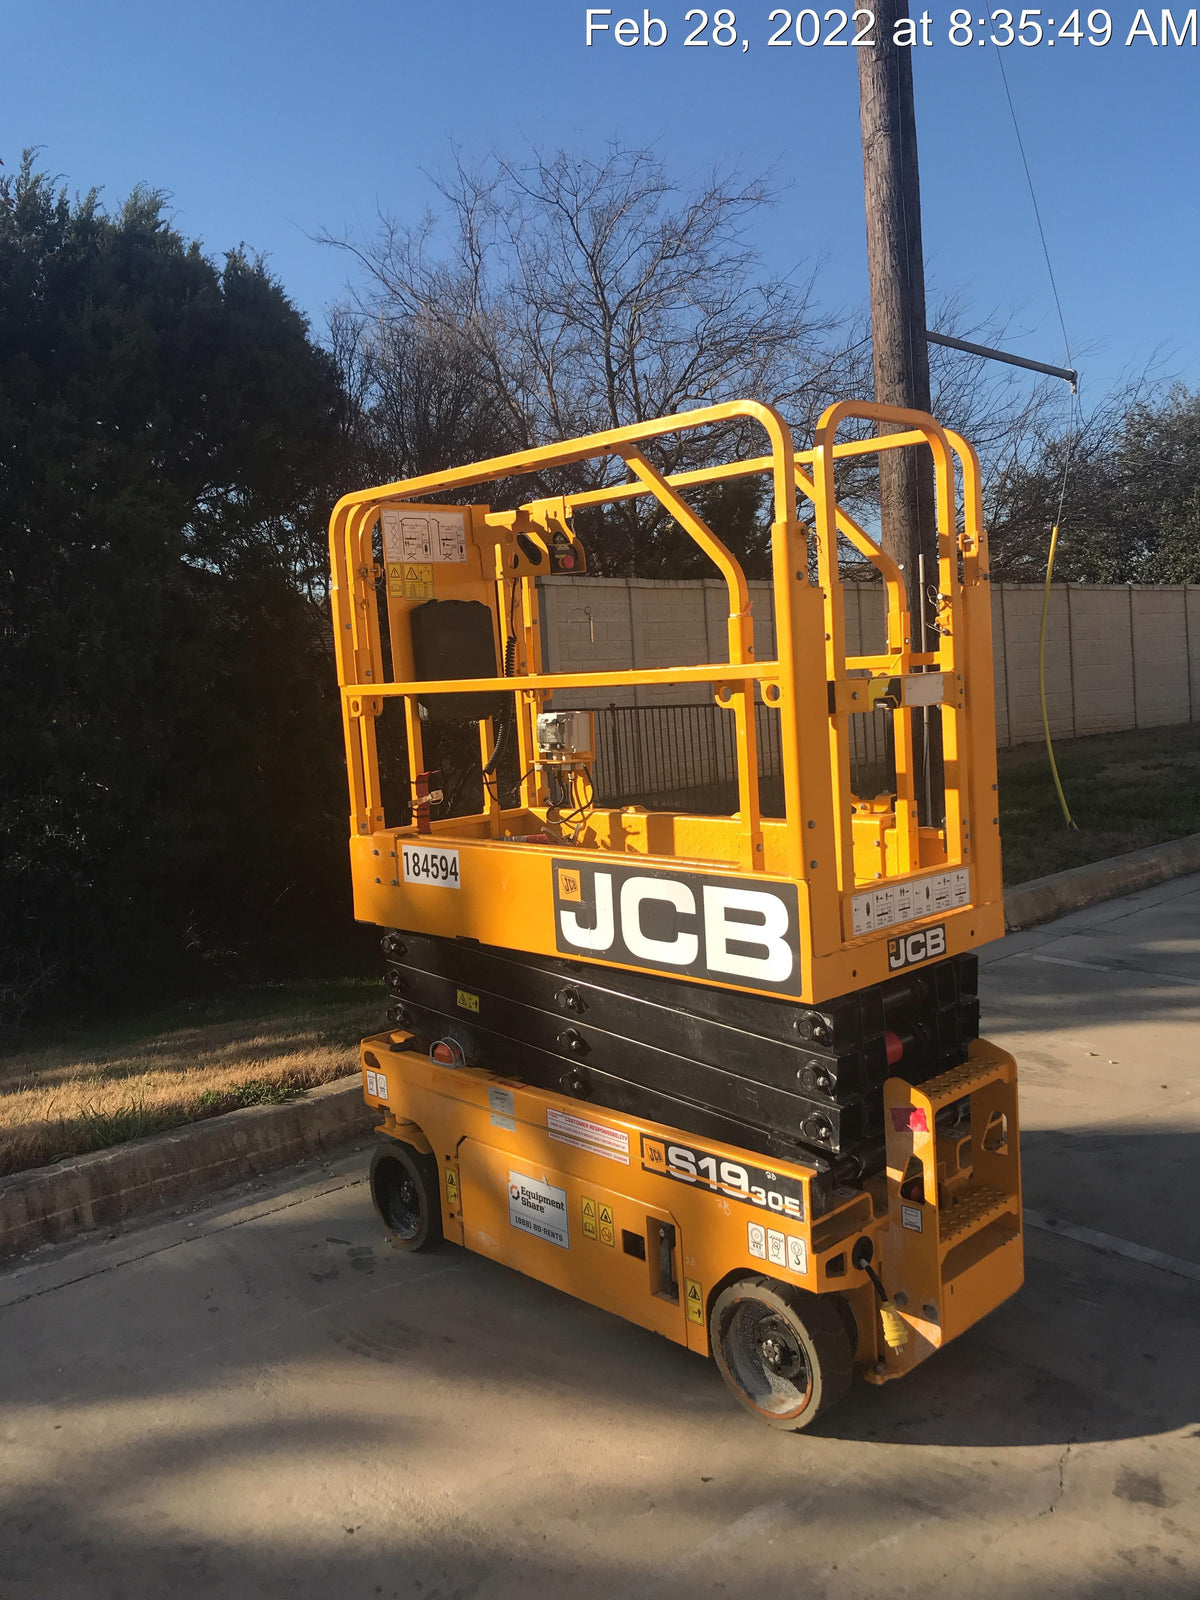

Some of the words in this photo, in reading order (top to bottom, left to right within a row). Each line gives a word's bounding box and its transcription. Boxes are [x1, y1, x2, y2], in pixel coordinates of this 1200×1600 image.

[403, 851, 459, 882] 184594
[559, 871, 793, 983] JCB
[889, 927, 946, 968] JCB
[520, 1185, 565, 1211] Equipment
[520, 1196, 545, 1214] Share
